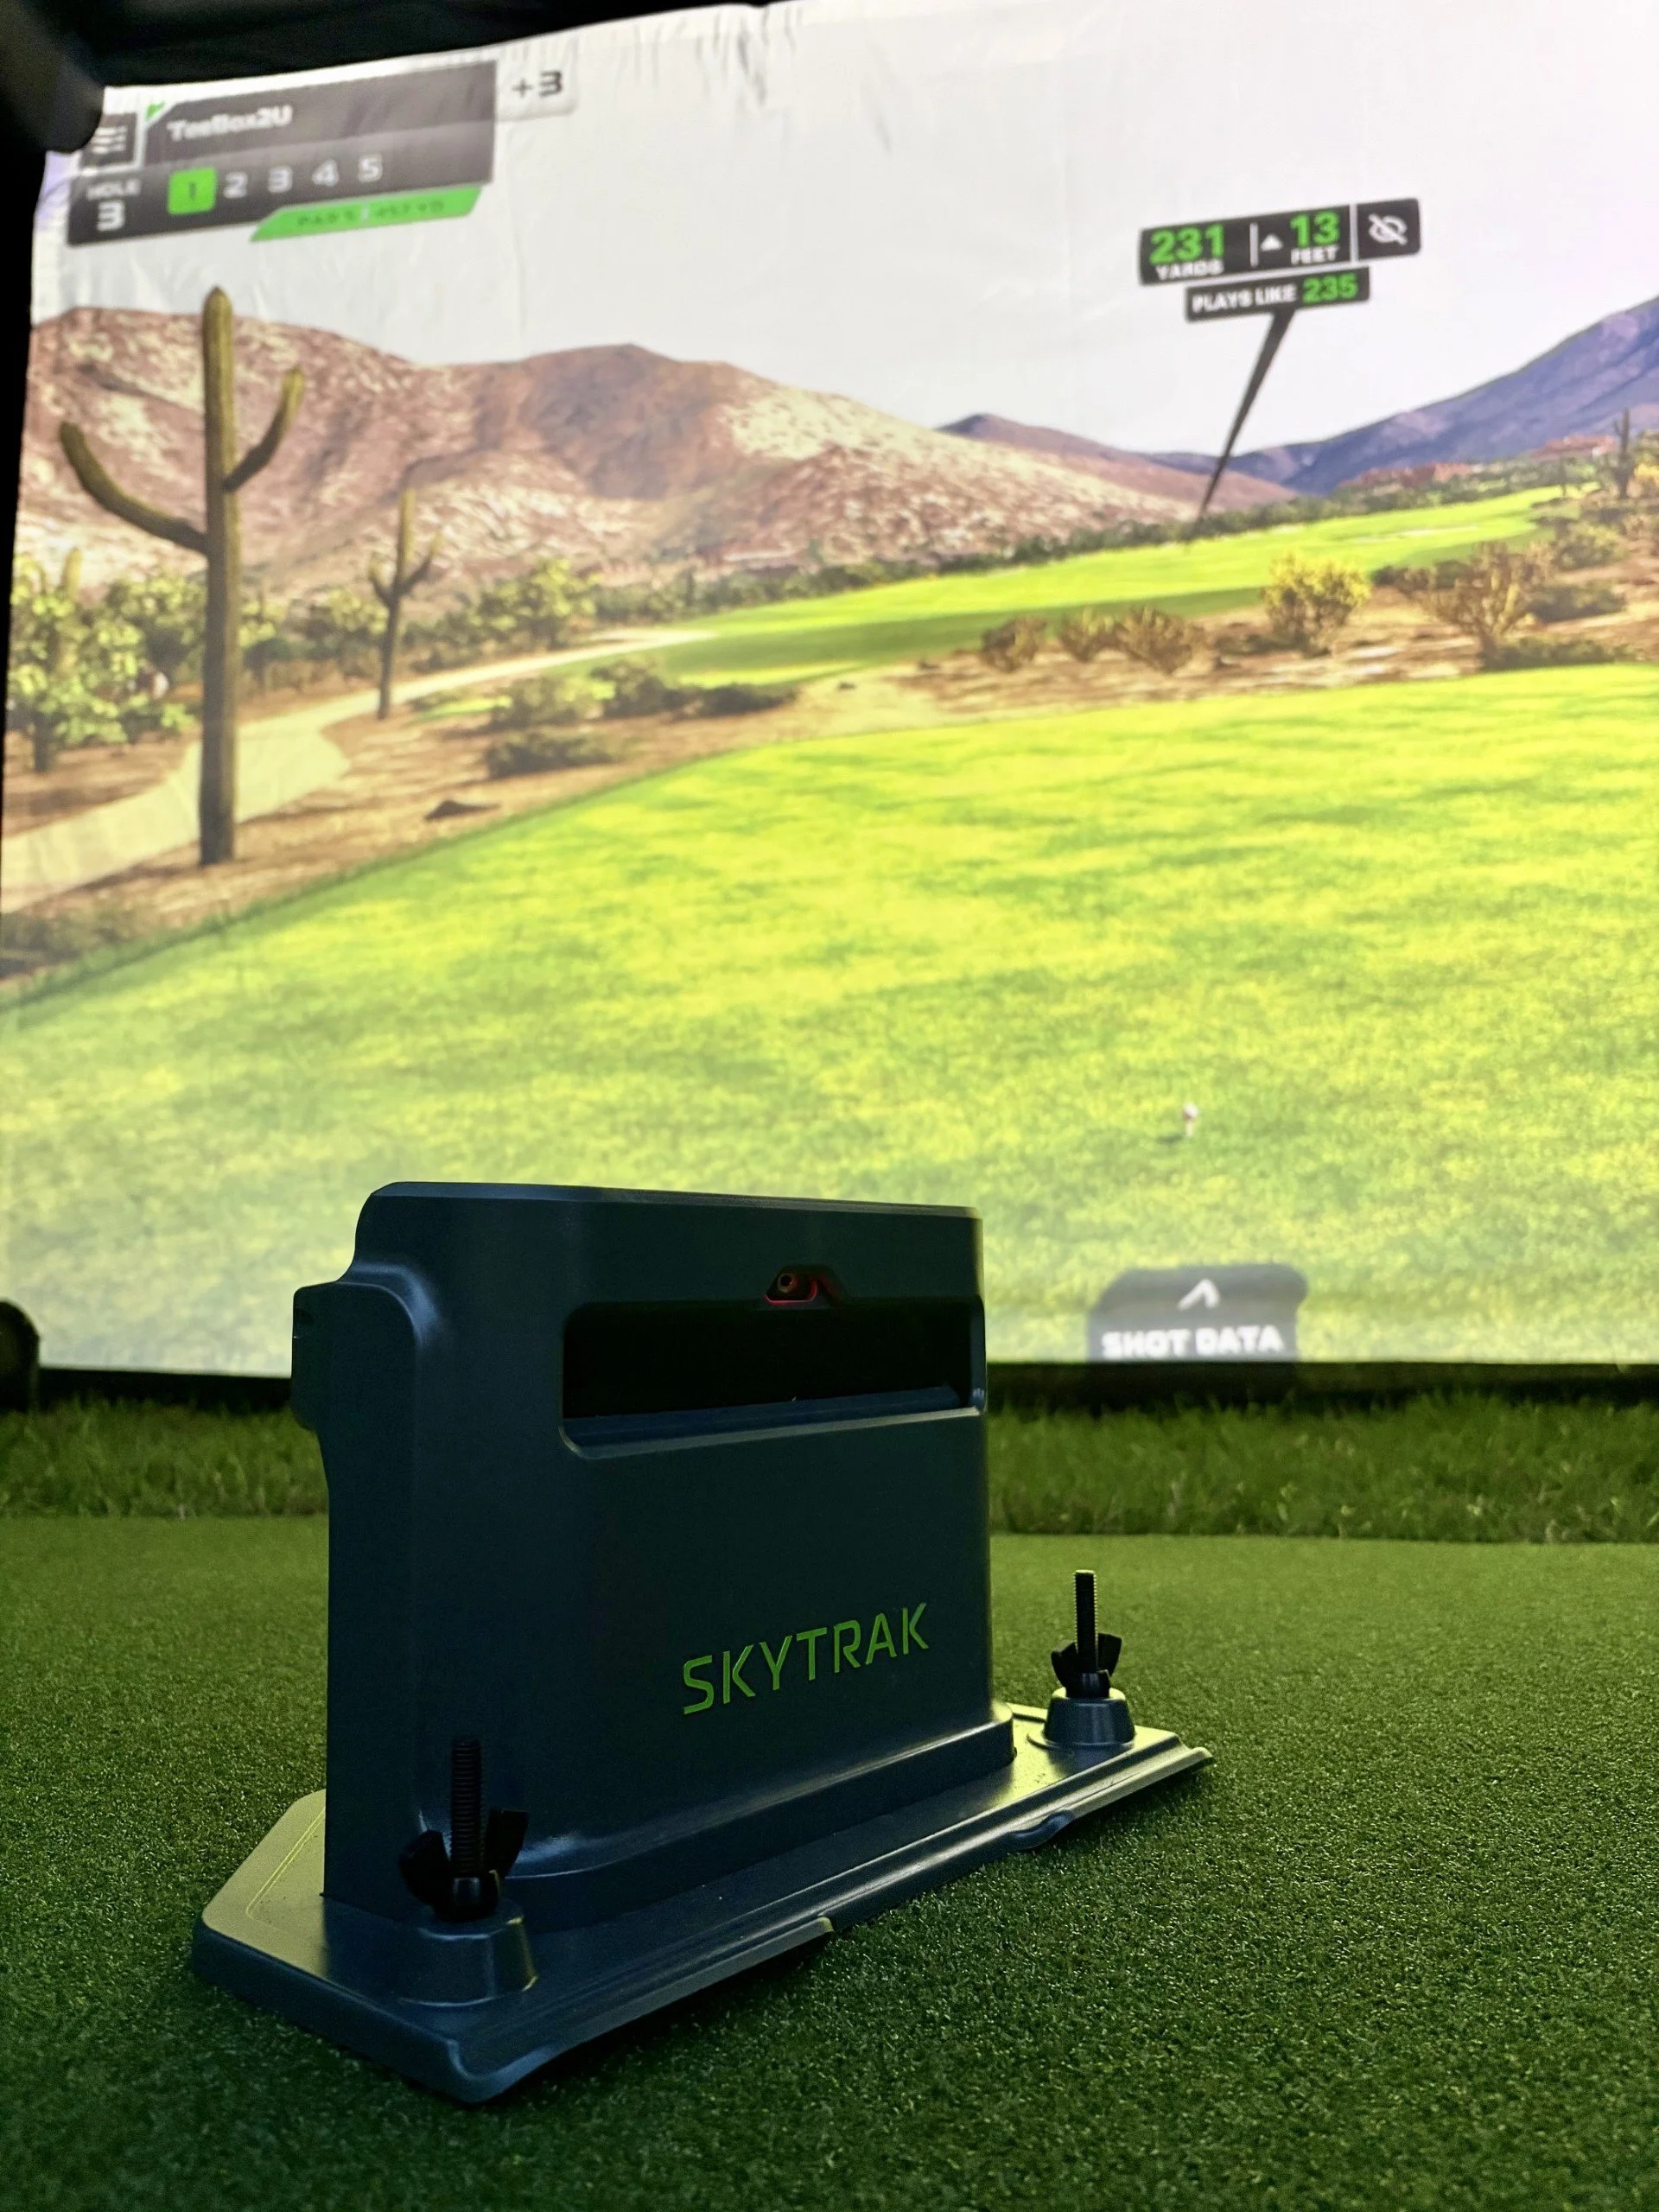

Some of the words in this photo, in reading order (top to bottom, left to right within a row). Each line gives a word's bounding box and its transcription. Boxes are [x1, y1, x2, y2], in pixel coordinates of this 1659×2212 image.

[223, 172, 249, 199] 2
[267, 166, 294, 194] 3
[310, 159, 340, 187] 4
[358, 154, 384, 182] 5
[96, 200, 125, 231] 3
[1290, 212, 1338, 247] 13
[1149, 224, 1225, 264] 231
[1291, 245, 1338, 264] FEET
[1155, 259, 1224, 280] YARDS
[1191, 290, 1253, 313] PLAYS
[1255, 283, 1297, 304] LIKE
[1302, 273, 1359, 303] 235
[1102, 1329, 1191, 1360] SHOT
[1196, 1325, 1286, 1357] DATA
[683, 1602, 930, 1715] SKYTRAK
